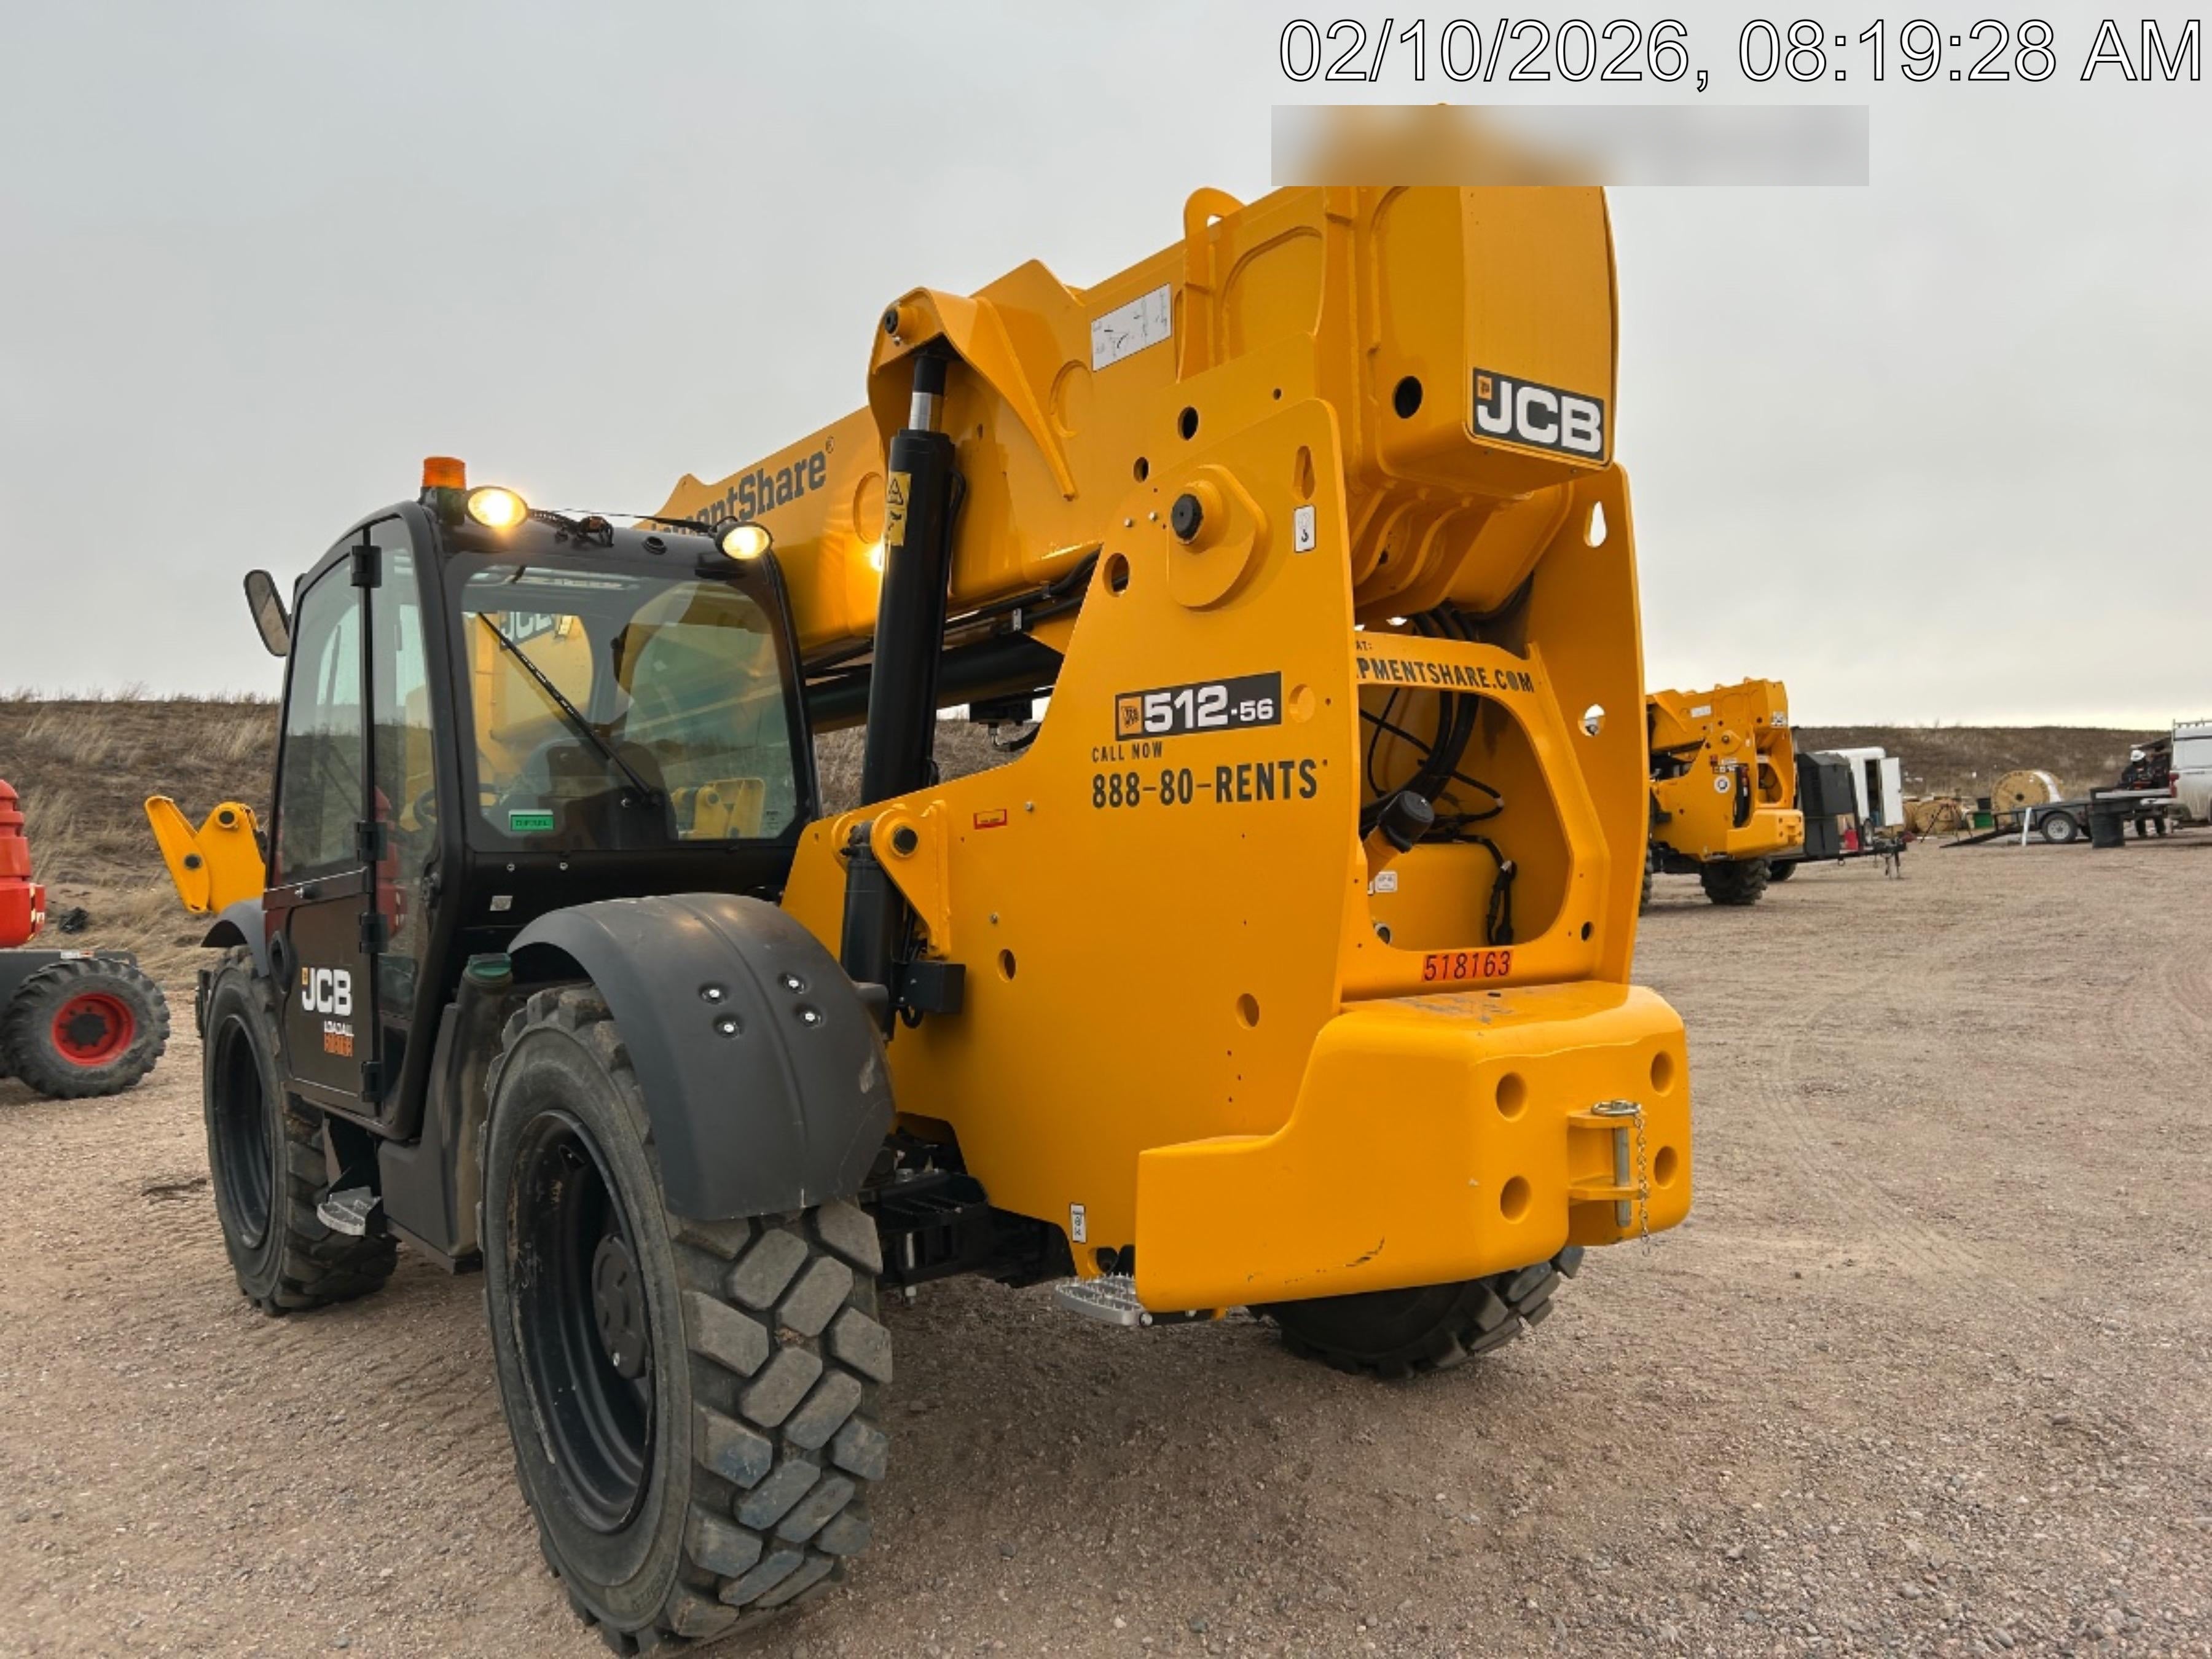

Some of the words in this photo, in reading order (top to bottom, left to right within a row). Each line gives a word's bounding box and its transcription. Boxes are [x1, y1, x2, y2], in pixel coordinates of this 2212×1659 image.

[1477, 380, 1602, 453] JCB
[1355, 657, 1535, 693] PMENTSHARE.COM
[1091, 744, 1125, 763] CALL
[1132, 741, 1163, 759] NOW
[1092, 758, 1317, 809] 888-80-RENTS
[1424, 951, 1511, 981] 518163
[301, 967, 353, 1016] JCB
